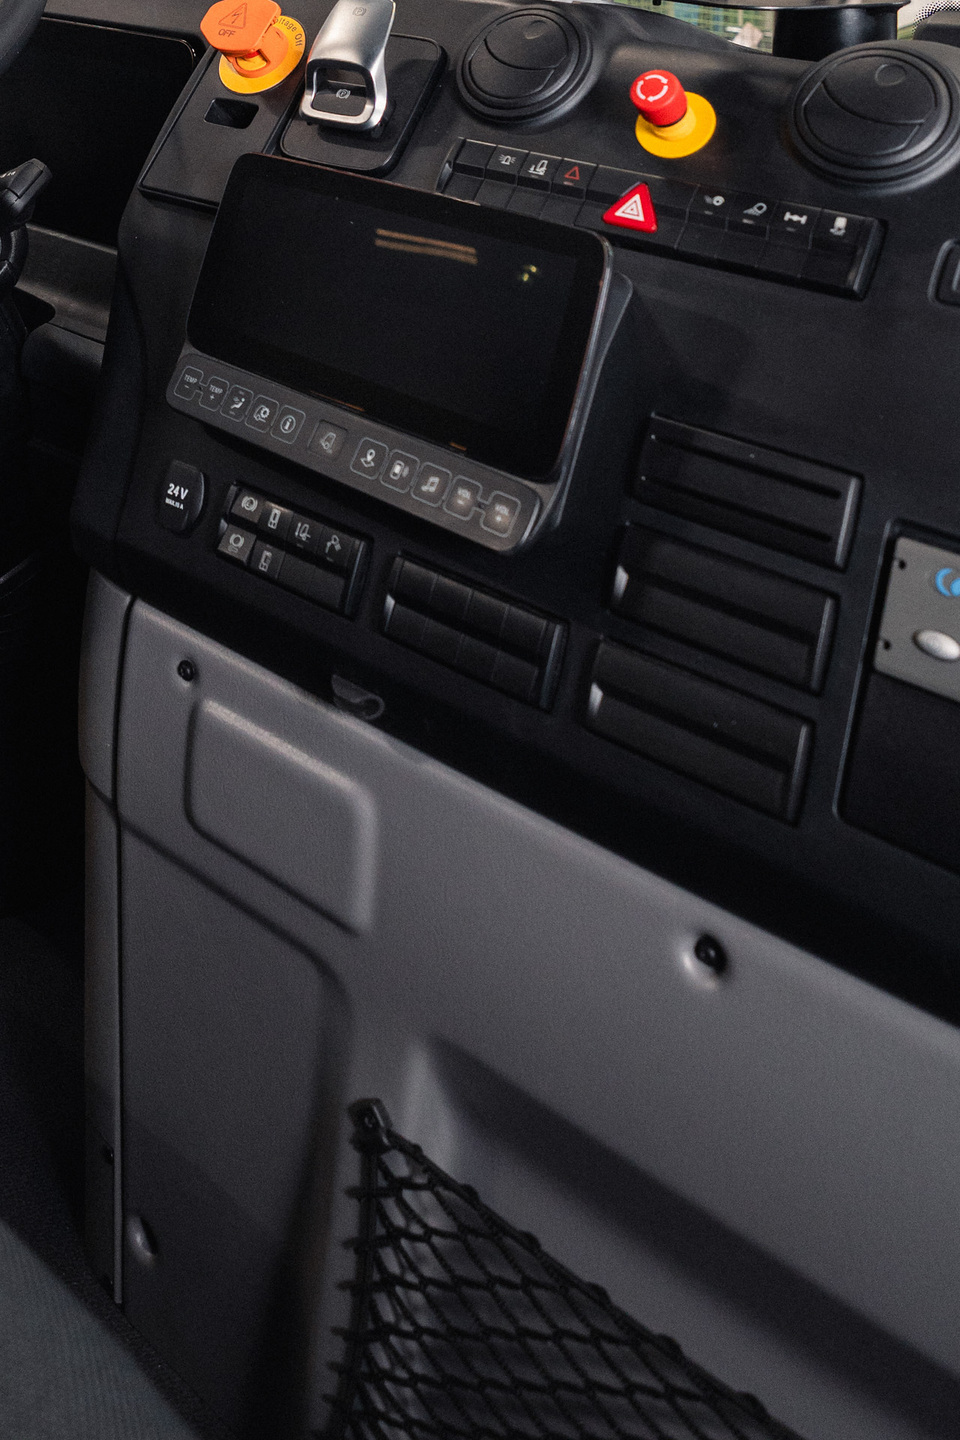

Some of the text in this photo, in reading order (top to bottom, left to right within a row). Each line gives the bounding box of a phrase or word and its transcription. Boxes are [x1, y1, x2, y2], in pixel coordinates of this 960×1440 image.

[218, 28, 236, 38] OFF
[184, 374, 198, 385] TEMP
[209, 384, 223, 395] TEMP
[167, 483, 189, 500] 24V
